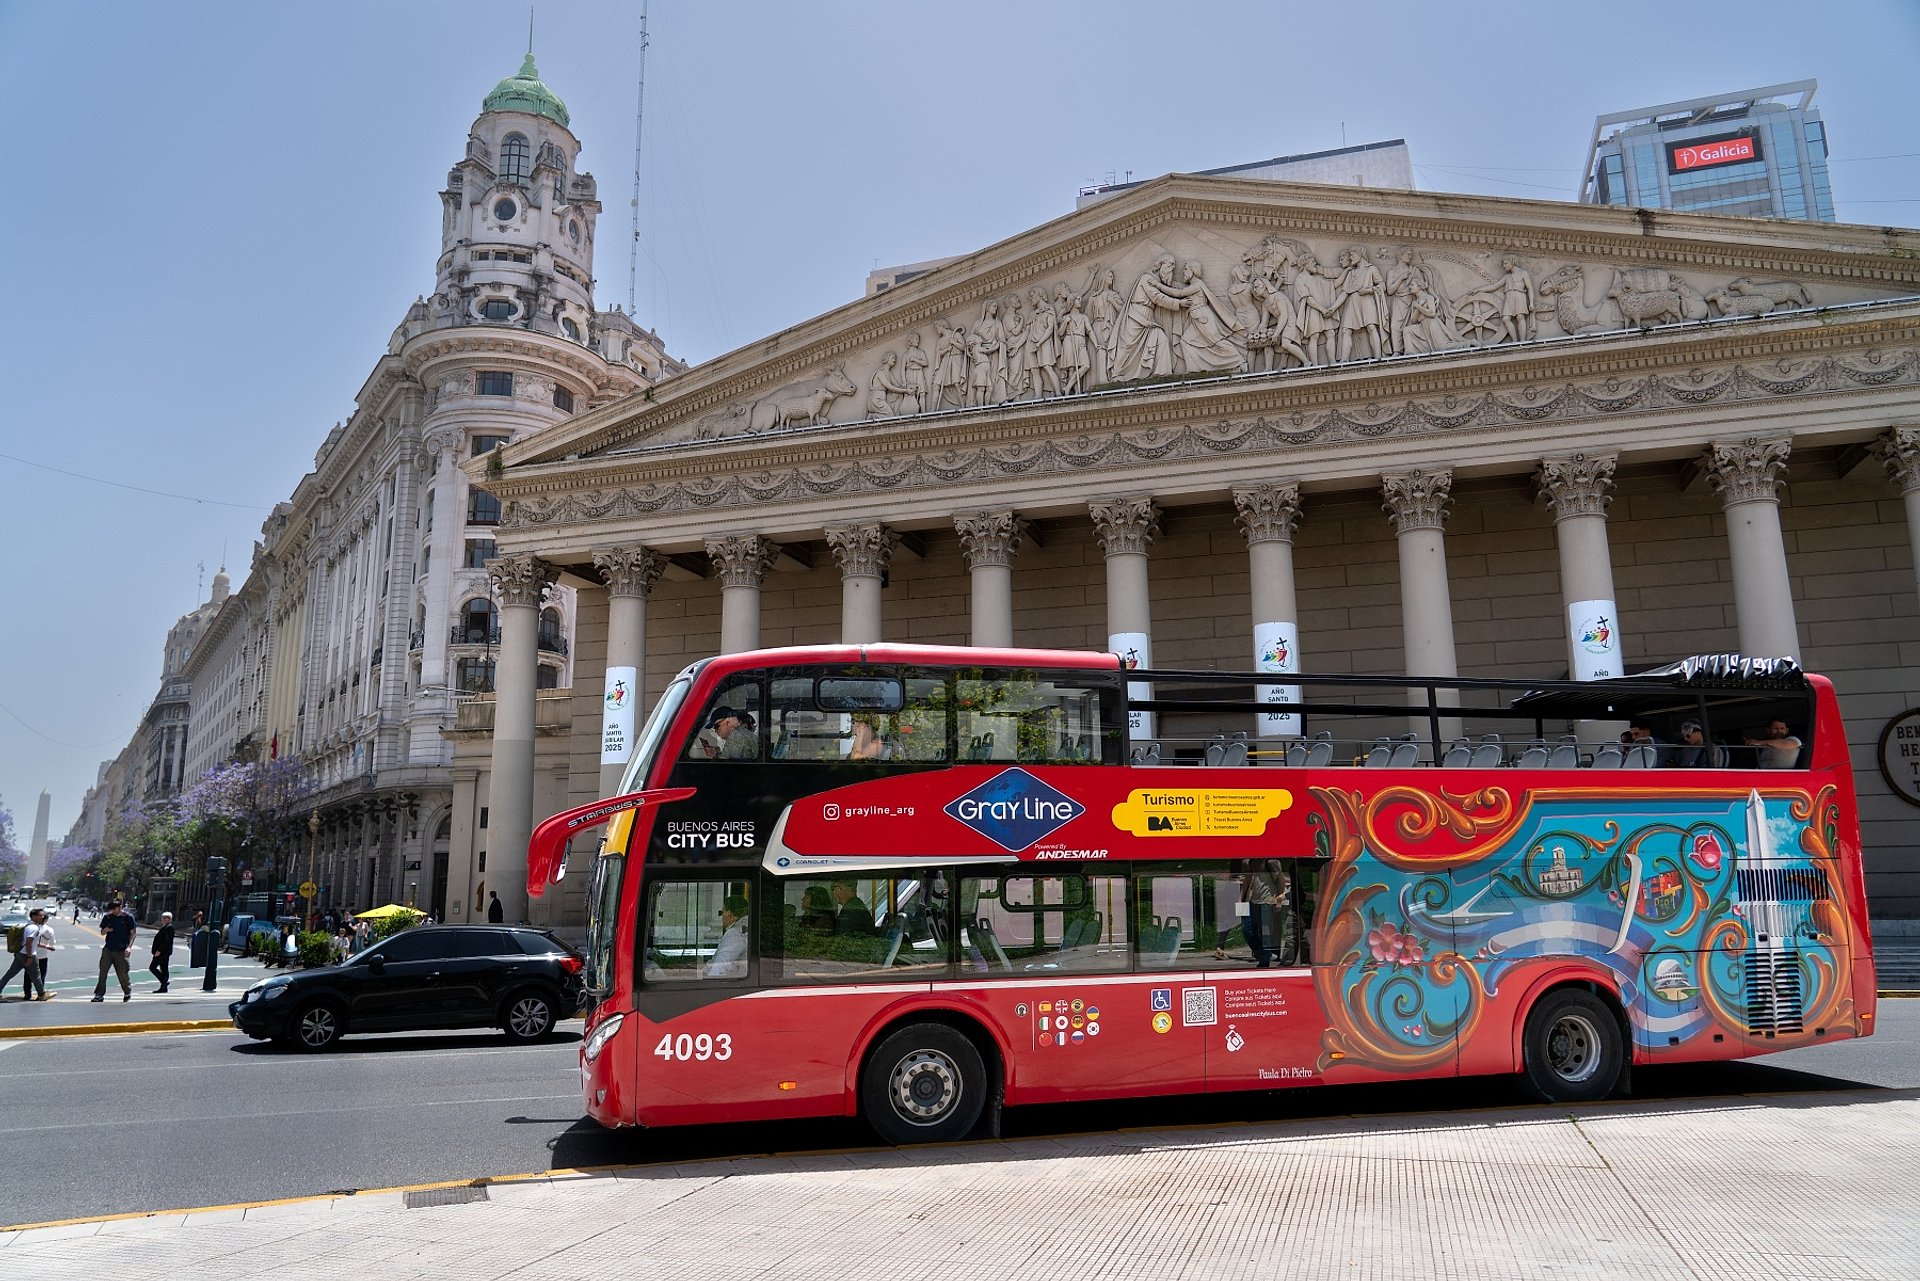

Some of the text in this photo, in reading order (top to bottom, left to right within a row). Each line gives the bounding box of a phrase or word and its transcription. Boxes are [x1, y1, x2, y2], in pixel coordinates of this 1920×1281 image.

[1700, 144, 1749, 160] Galicia
[1594, 669, 1608, 677] AÑO
[1271, 687, 1284, 695] AÑO
[1268, 713, 1290, 721] 2025
[605, 744, 622, 752] 2025
[1142, 794, 1195, 806] Turismo
[845, 806, 915, 817] grayline_arg
[668, 822, 755, 832] BUENOS AIRES
[1147, 816, 1174, 831] BA
[667, 833, 755, 848] CITY BUS
[1035, 850, 1108, 859] ANDESMAR
[654, 1033, 732, 1061] 4093
[1259, 1067, 1313, 1079] Paula Di Pietro
